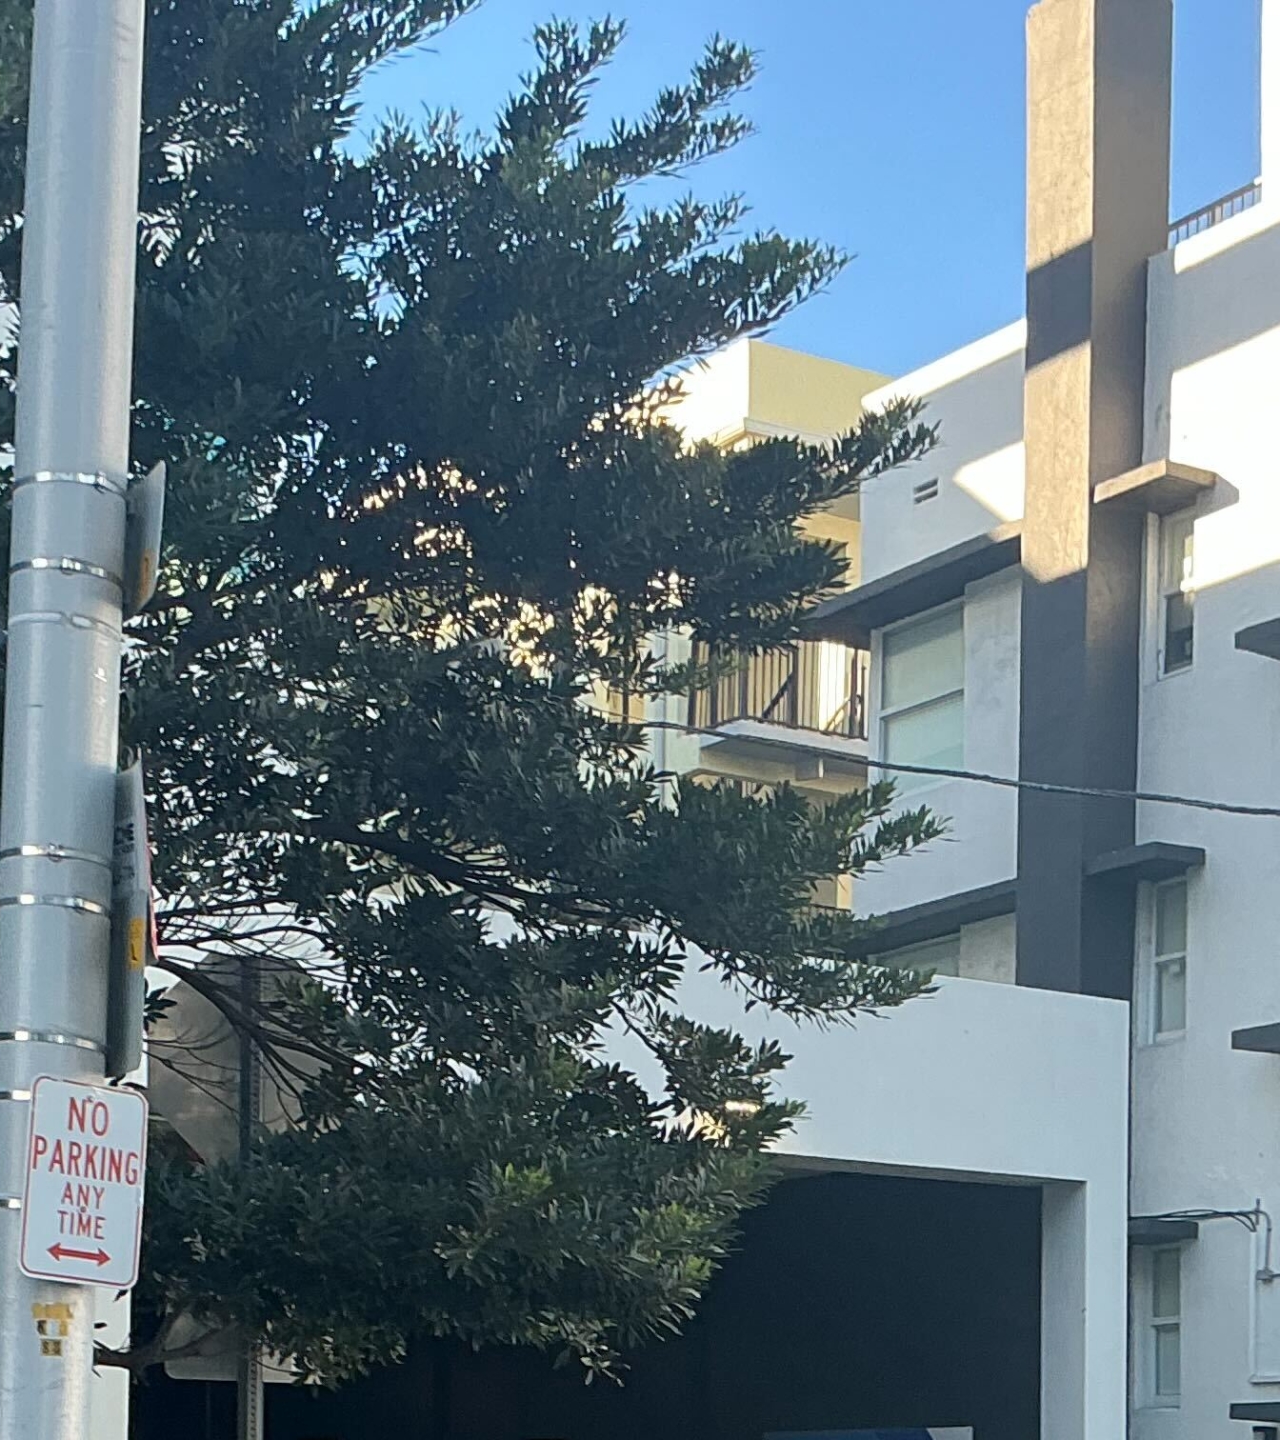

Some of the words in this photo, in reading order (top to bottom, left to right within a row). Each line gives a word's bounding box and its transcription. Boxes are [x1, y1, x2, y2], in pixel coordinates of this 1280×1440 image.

[67, 1096, 110, 1136] NO
[32, 1135, 139, 1186] PARKING
[61, 1182, 105, 1209] ANY
[57, 1210, 106, 1240] TIME
